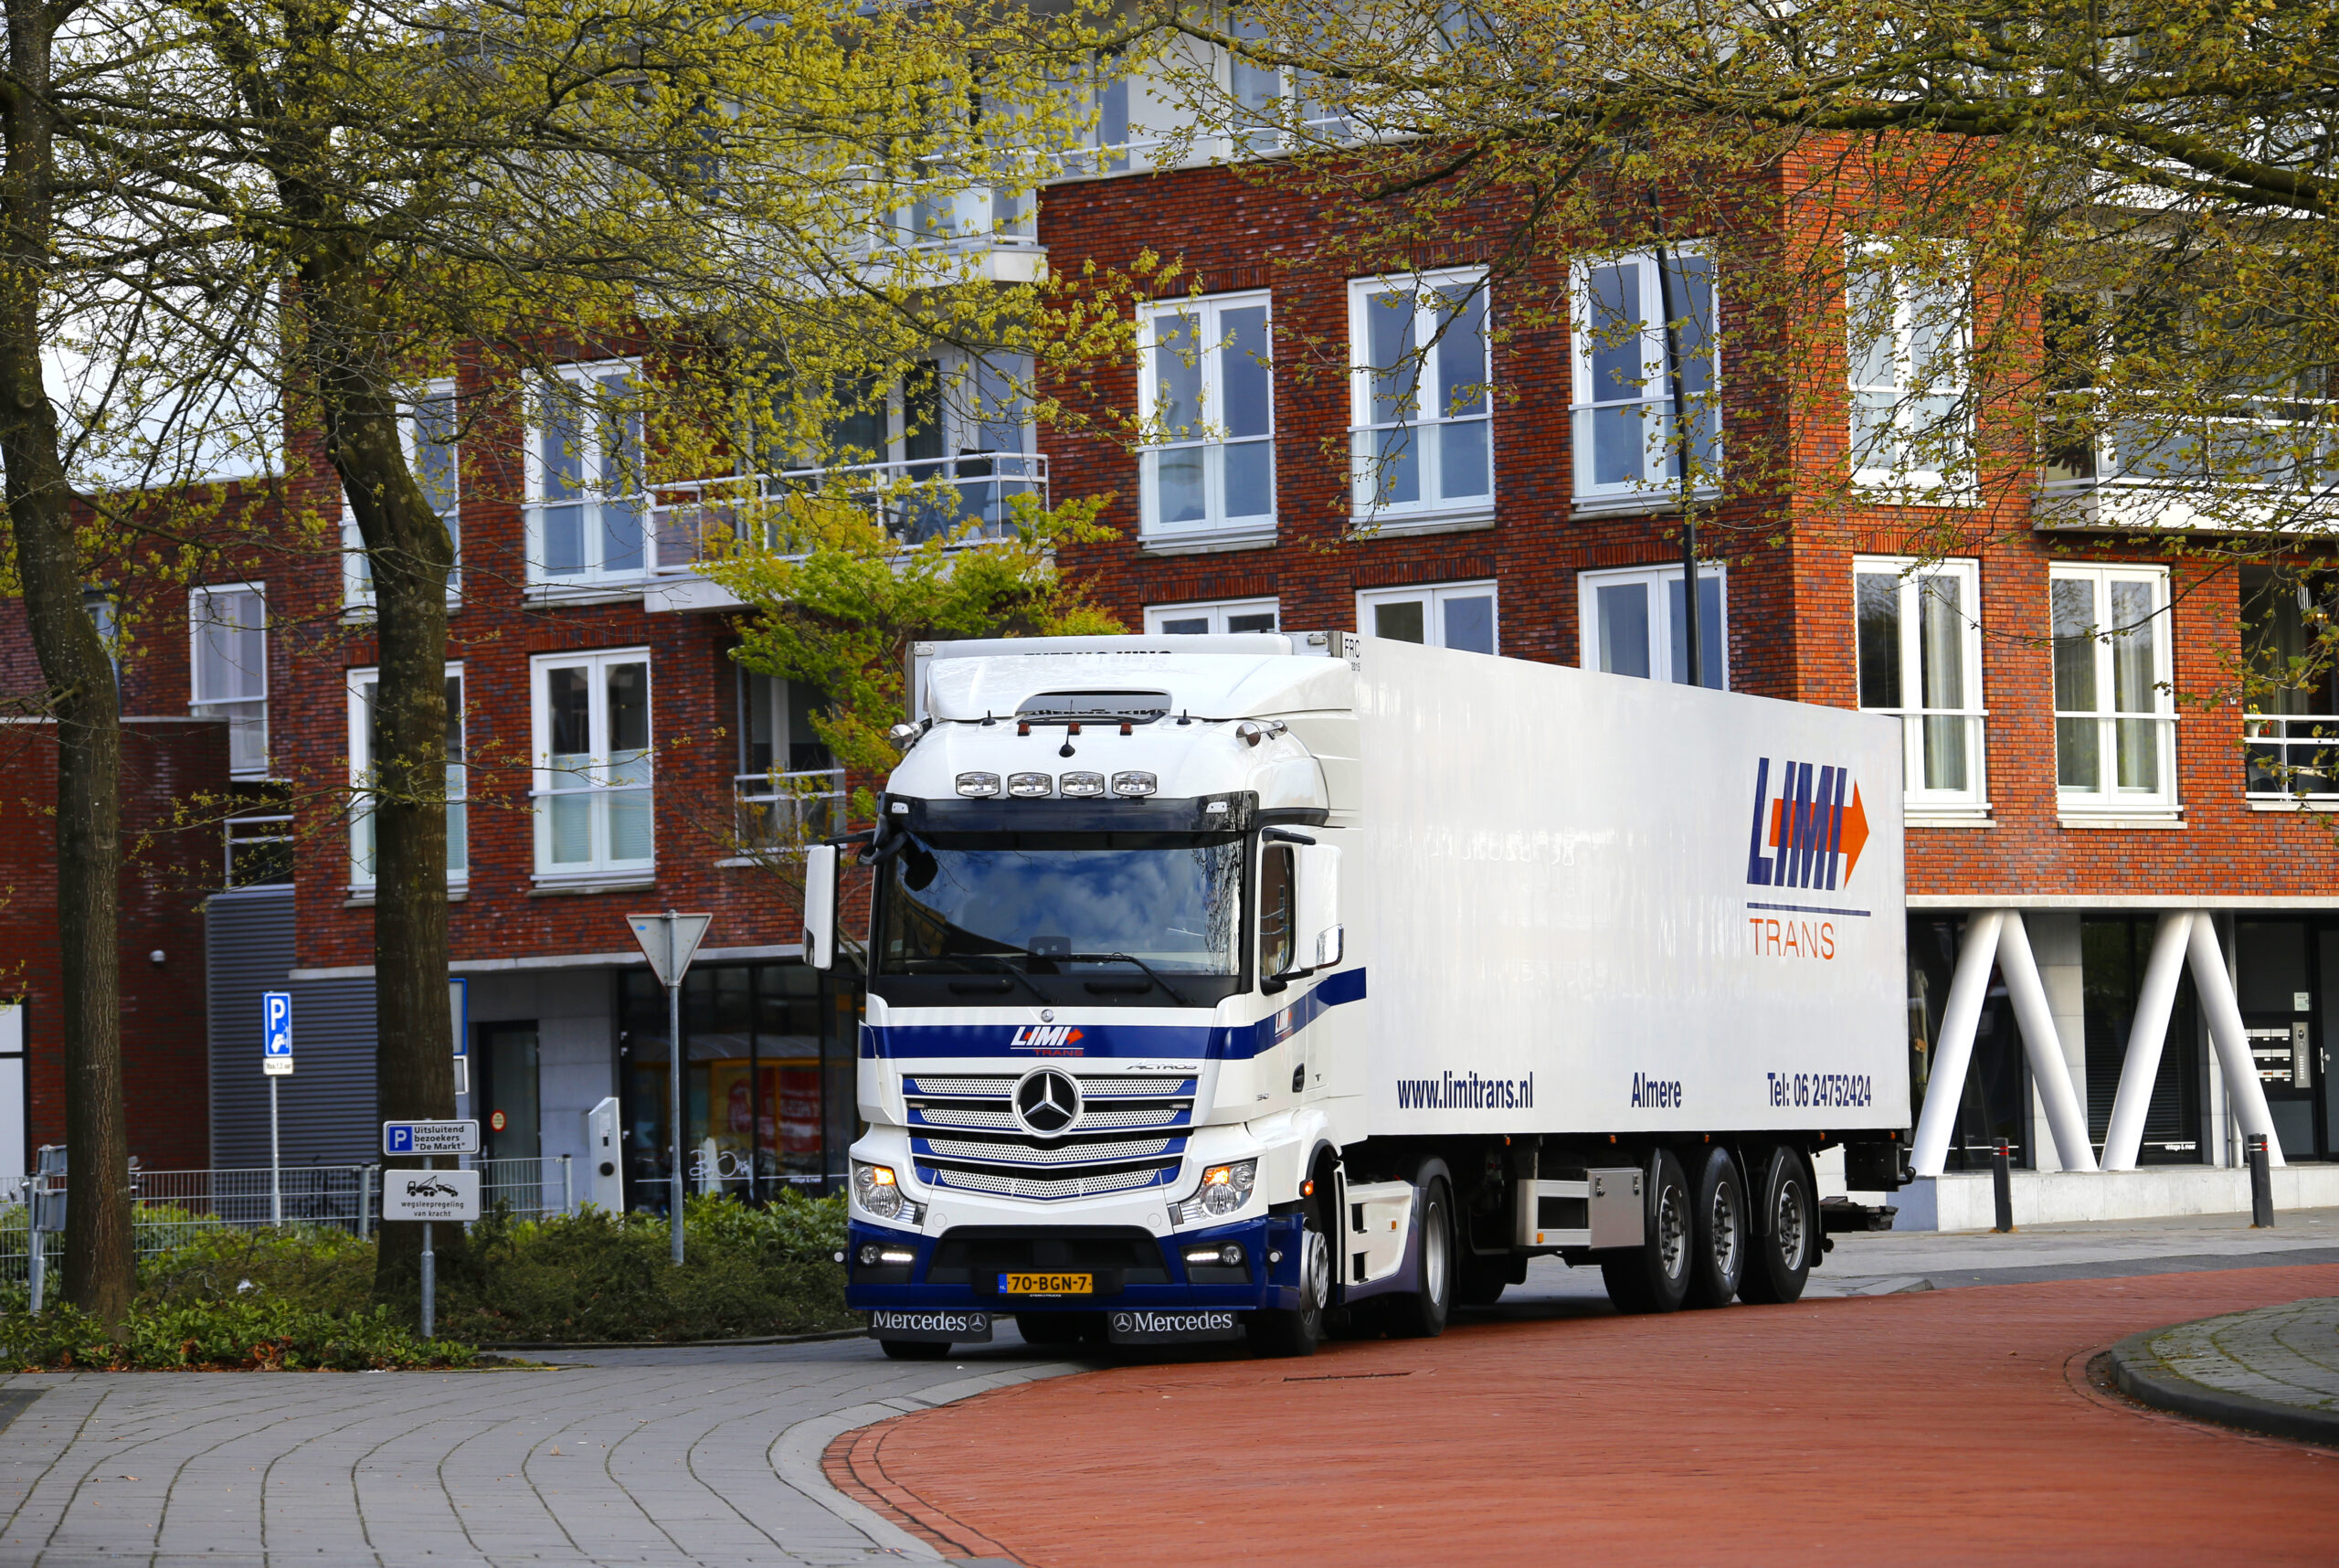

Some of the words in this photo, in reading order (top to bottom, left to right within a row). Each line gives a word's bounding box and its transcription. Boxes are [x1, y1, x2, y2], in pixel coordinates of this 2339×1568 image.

[1345, 638, 1360, 658] FRC
[1747, 757, 1847, 891] LIMI
[1749, 917, 1835, 960] TRANS
[270, 998, 286, 1031] P
[1010, 1026, 1072, 1046] LIMI
[1397, 1070, 1533, 1108] www.limitrans.nl
[1631, 1072, 1682, 1107] Almere
[1767, 1073, 1790, 1107] Tel:
[1794, 1074, 1809, 1107] 06
[1813, 1074, 1871, 1107] 24752424
[395, 1129, 407, 1149] P
[414, 1126, 464, 1134] Uitsluitend
[414, 1134, 460, 1142] bezoekers
[434, 1142, 465, 1150] Markt"
[401, 1201, 464, 1209] wegsleepregeling
[1011, 1277, 1087, 1290] 70-BGN-7
[872, 1310, 967, 1331] Mercedes
[1134, 1312, 1233, 1332] Mercedes
